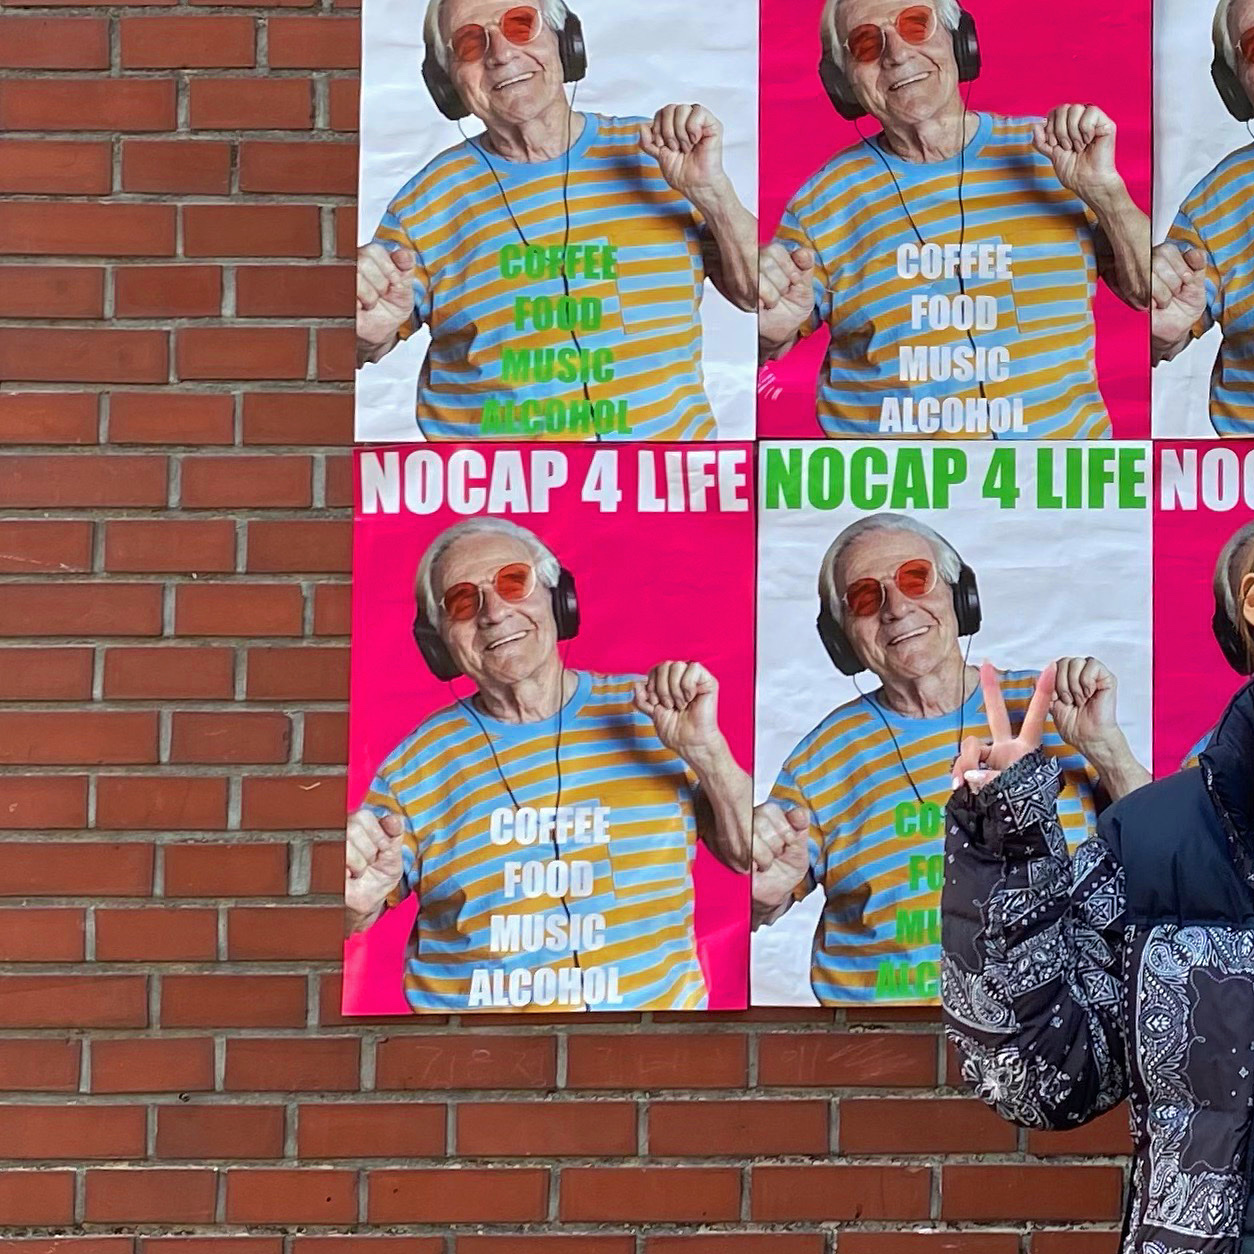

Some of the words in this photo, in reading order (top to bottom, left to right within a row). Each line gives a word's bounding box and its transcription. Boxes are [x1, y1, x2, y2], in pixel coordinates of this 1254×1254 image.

[500, 243, 618, 280] COFFEE
[897, 243, 1013, 280] COFFEE
[514, 295, 602, 331] FOOD
[911, 295, 998, 331] FOOD
[500, 347, 615, 383] MUSIC
[899, 346, 1010, 382] MUSIC
[480, 398, 633, 436] ALCOHOL
[878, 397, 1029, 434] ALCOHOL
[360, 449, 570, 516] NOCAP
[581, 450, 622, 514] 4
[637, 450, 749, 513] LIFE
[765, 446, 968, 511] NOCAP
[981, 447, 1021, 510] 4
[1036, 447, 1147, 510] LIFE
[489, 805, 611, 846] COFFEE
[503, 859, 594, 899] FOOD
[908, 854, 944, 891] FO
[489, 913, 606, 954] MUSIC
[468, 966, 623, 1008] ALCOHOL
